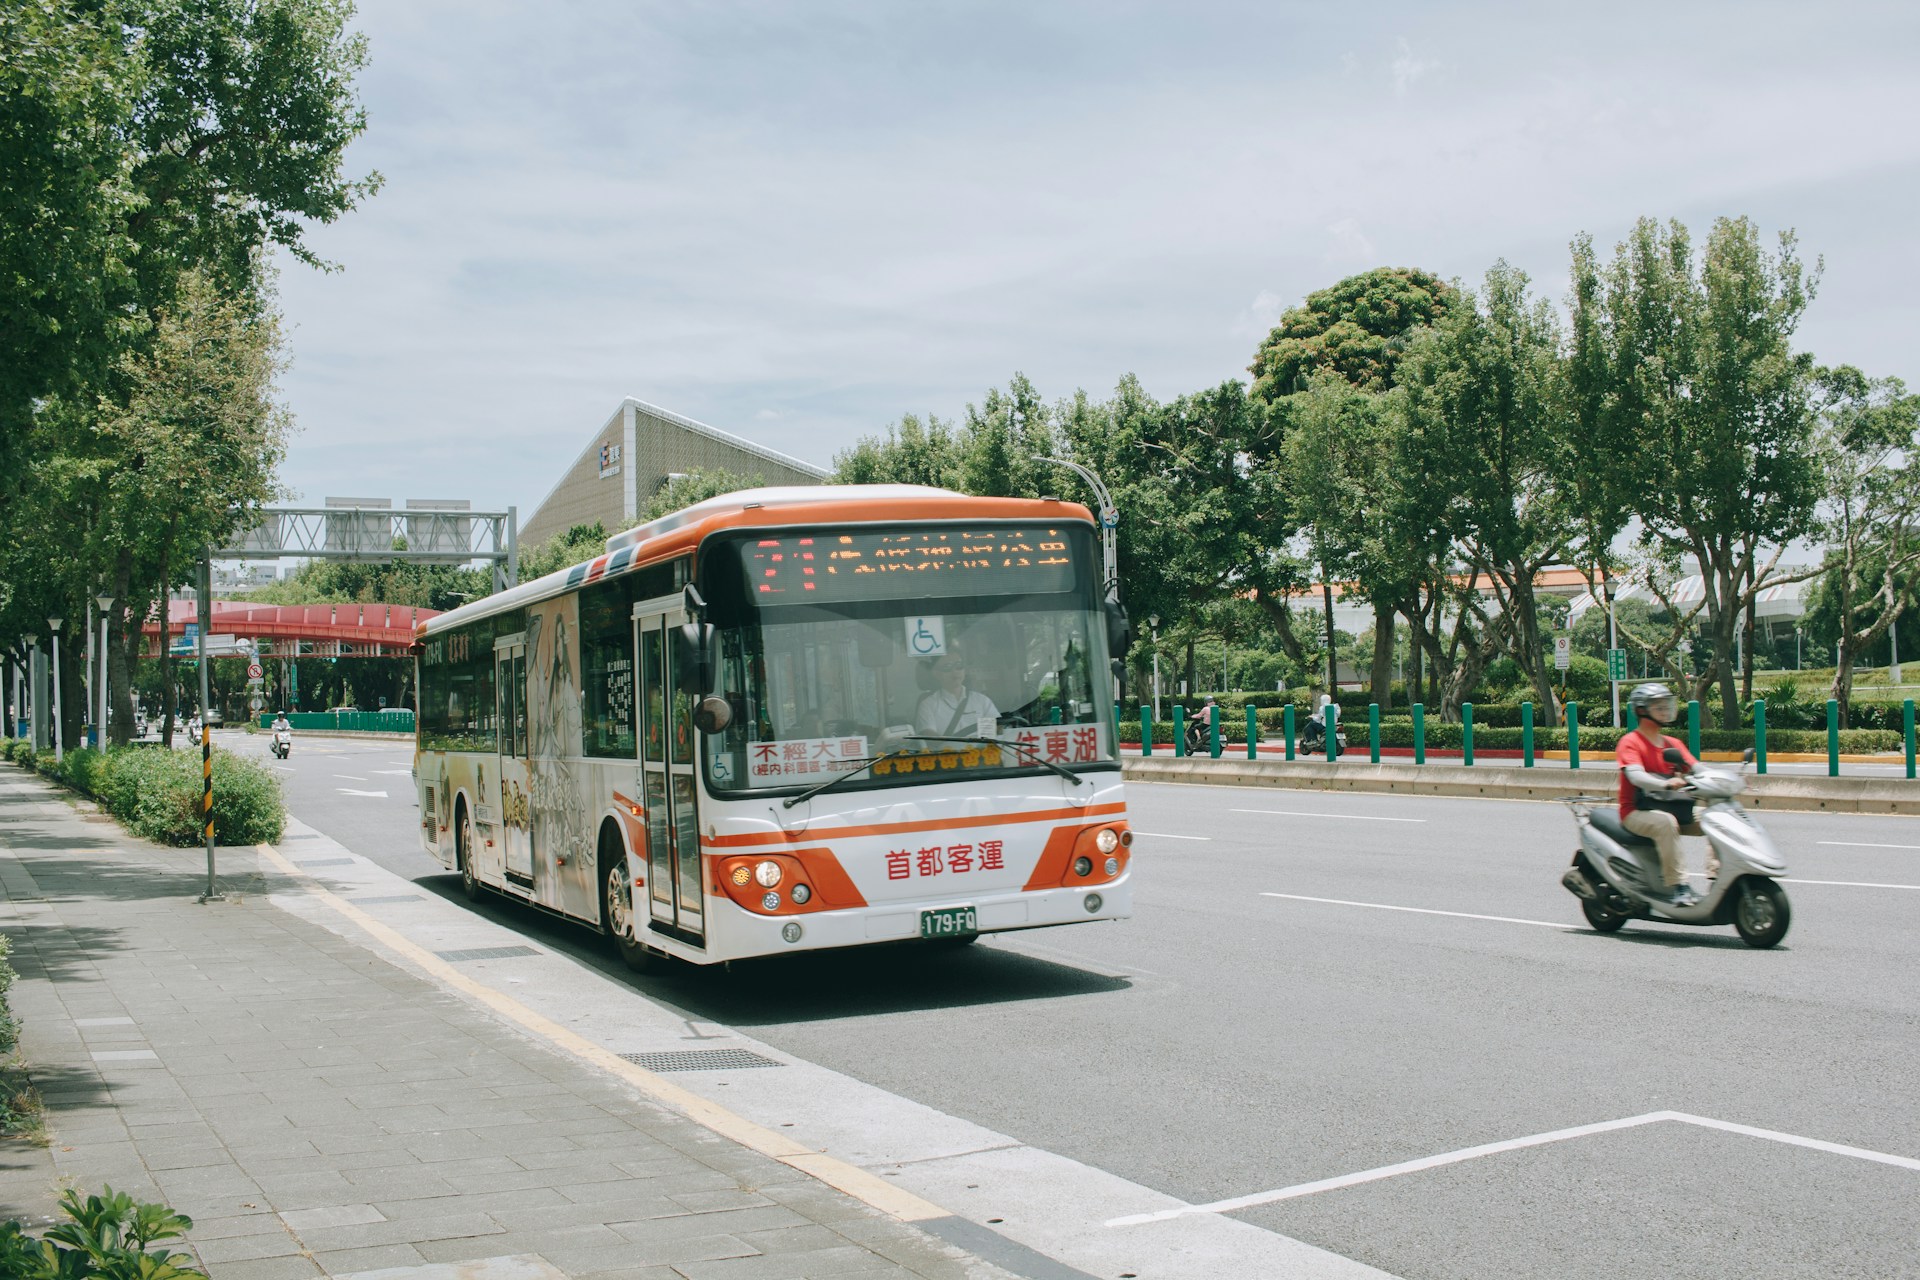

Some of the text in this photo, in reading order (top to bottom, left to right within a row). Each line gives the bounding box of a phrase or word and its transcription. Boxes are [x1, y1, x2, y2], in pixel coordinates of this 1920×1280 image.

[753, 738, 864, 762] 不經大直
[1015, 727, 1098, 766] 往東湖
[885, 840, 1004, 880] 首都客運
[925, 911, 976, 934] 179-FQ
